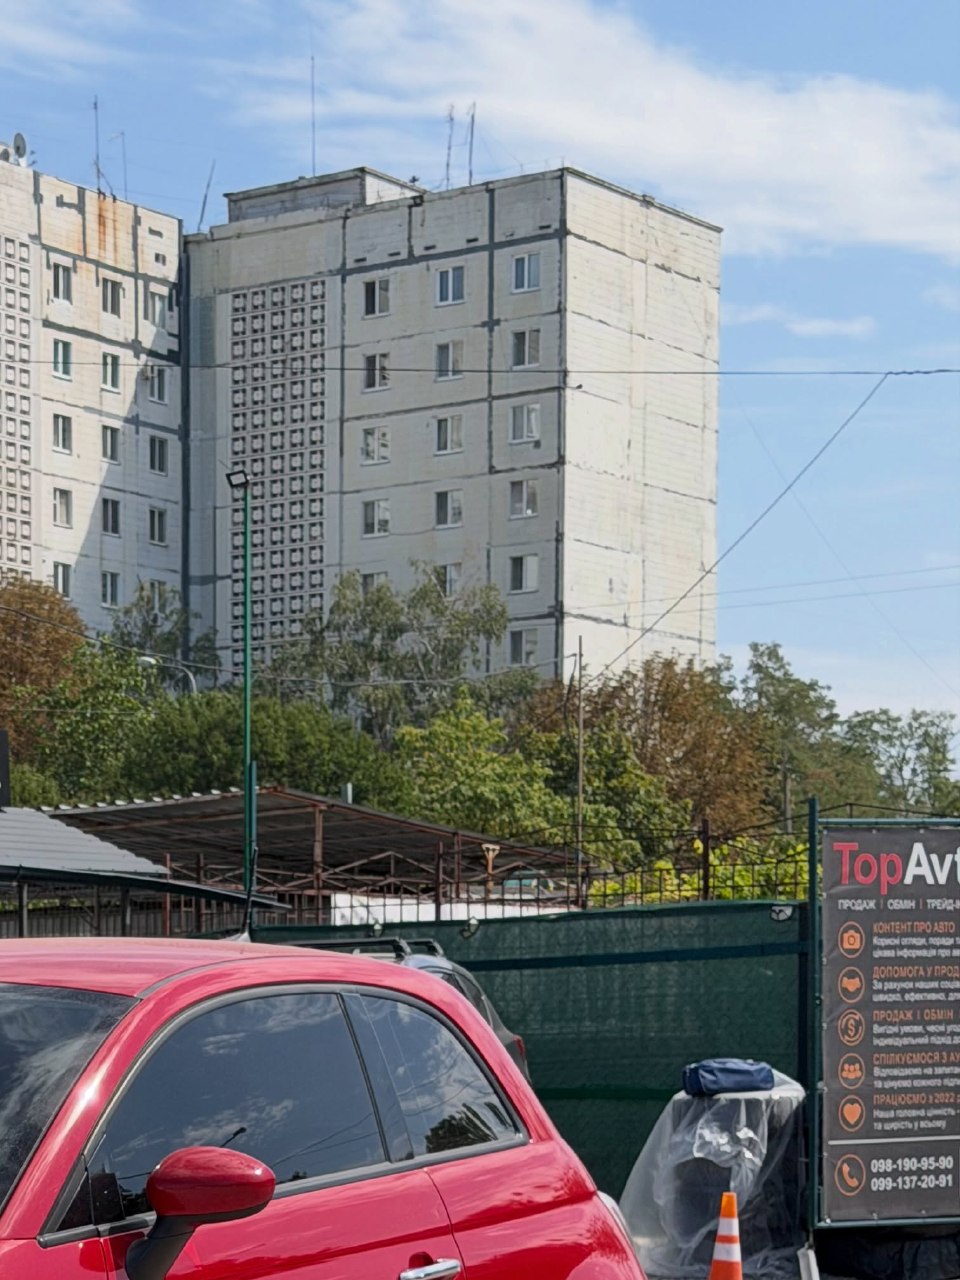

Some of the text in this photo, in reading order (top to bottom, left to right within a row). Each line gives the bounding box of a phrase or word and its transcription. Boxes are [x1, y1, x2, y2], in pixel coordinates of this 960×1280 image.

[838, 899, 876, 911] ПРОДАЖ
[873, 921, 955, 933] КОНТЕНТ ПРО АВТО
[873, 966, 924, 979] ДОПОМОГА
[873, 1010, 913, 1023] ПРОДАЖ
[871, 1155, 954, 1173] 098-190-95-90
[871, 1174, 953, 1191] 099-137-20-91
